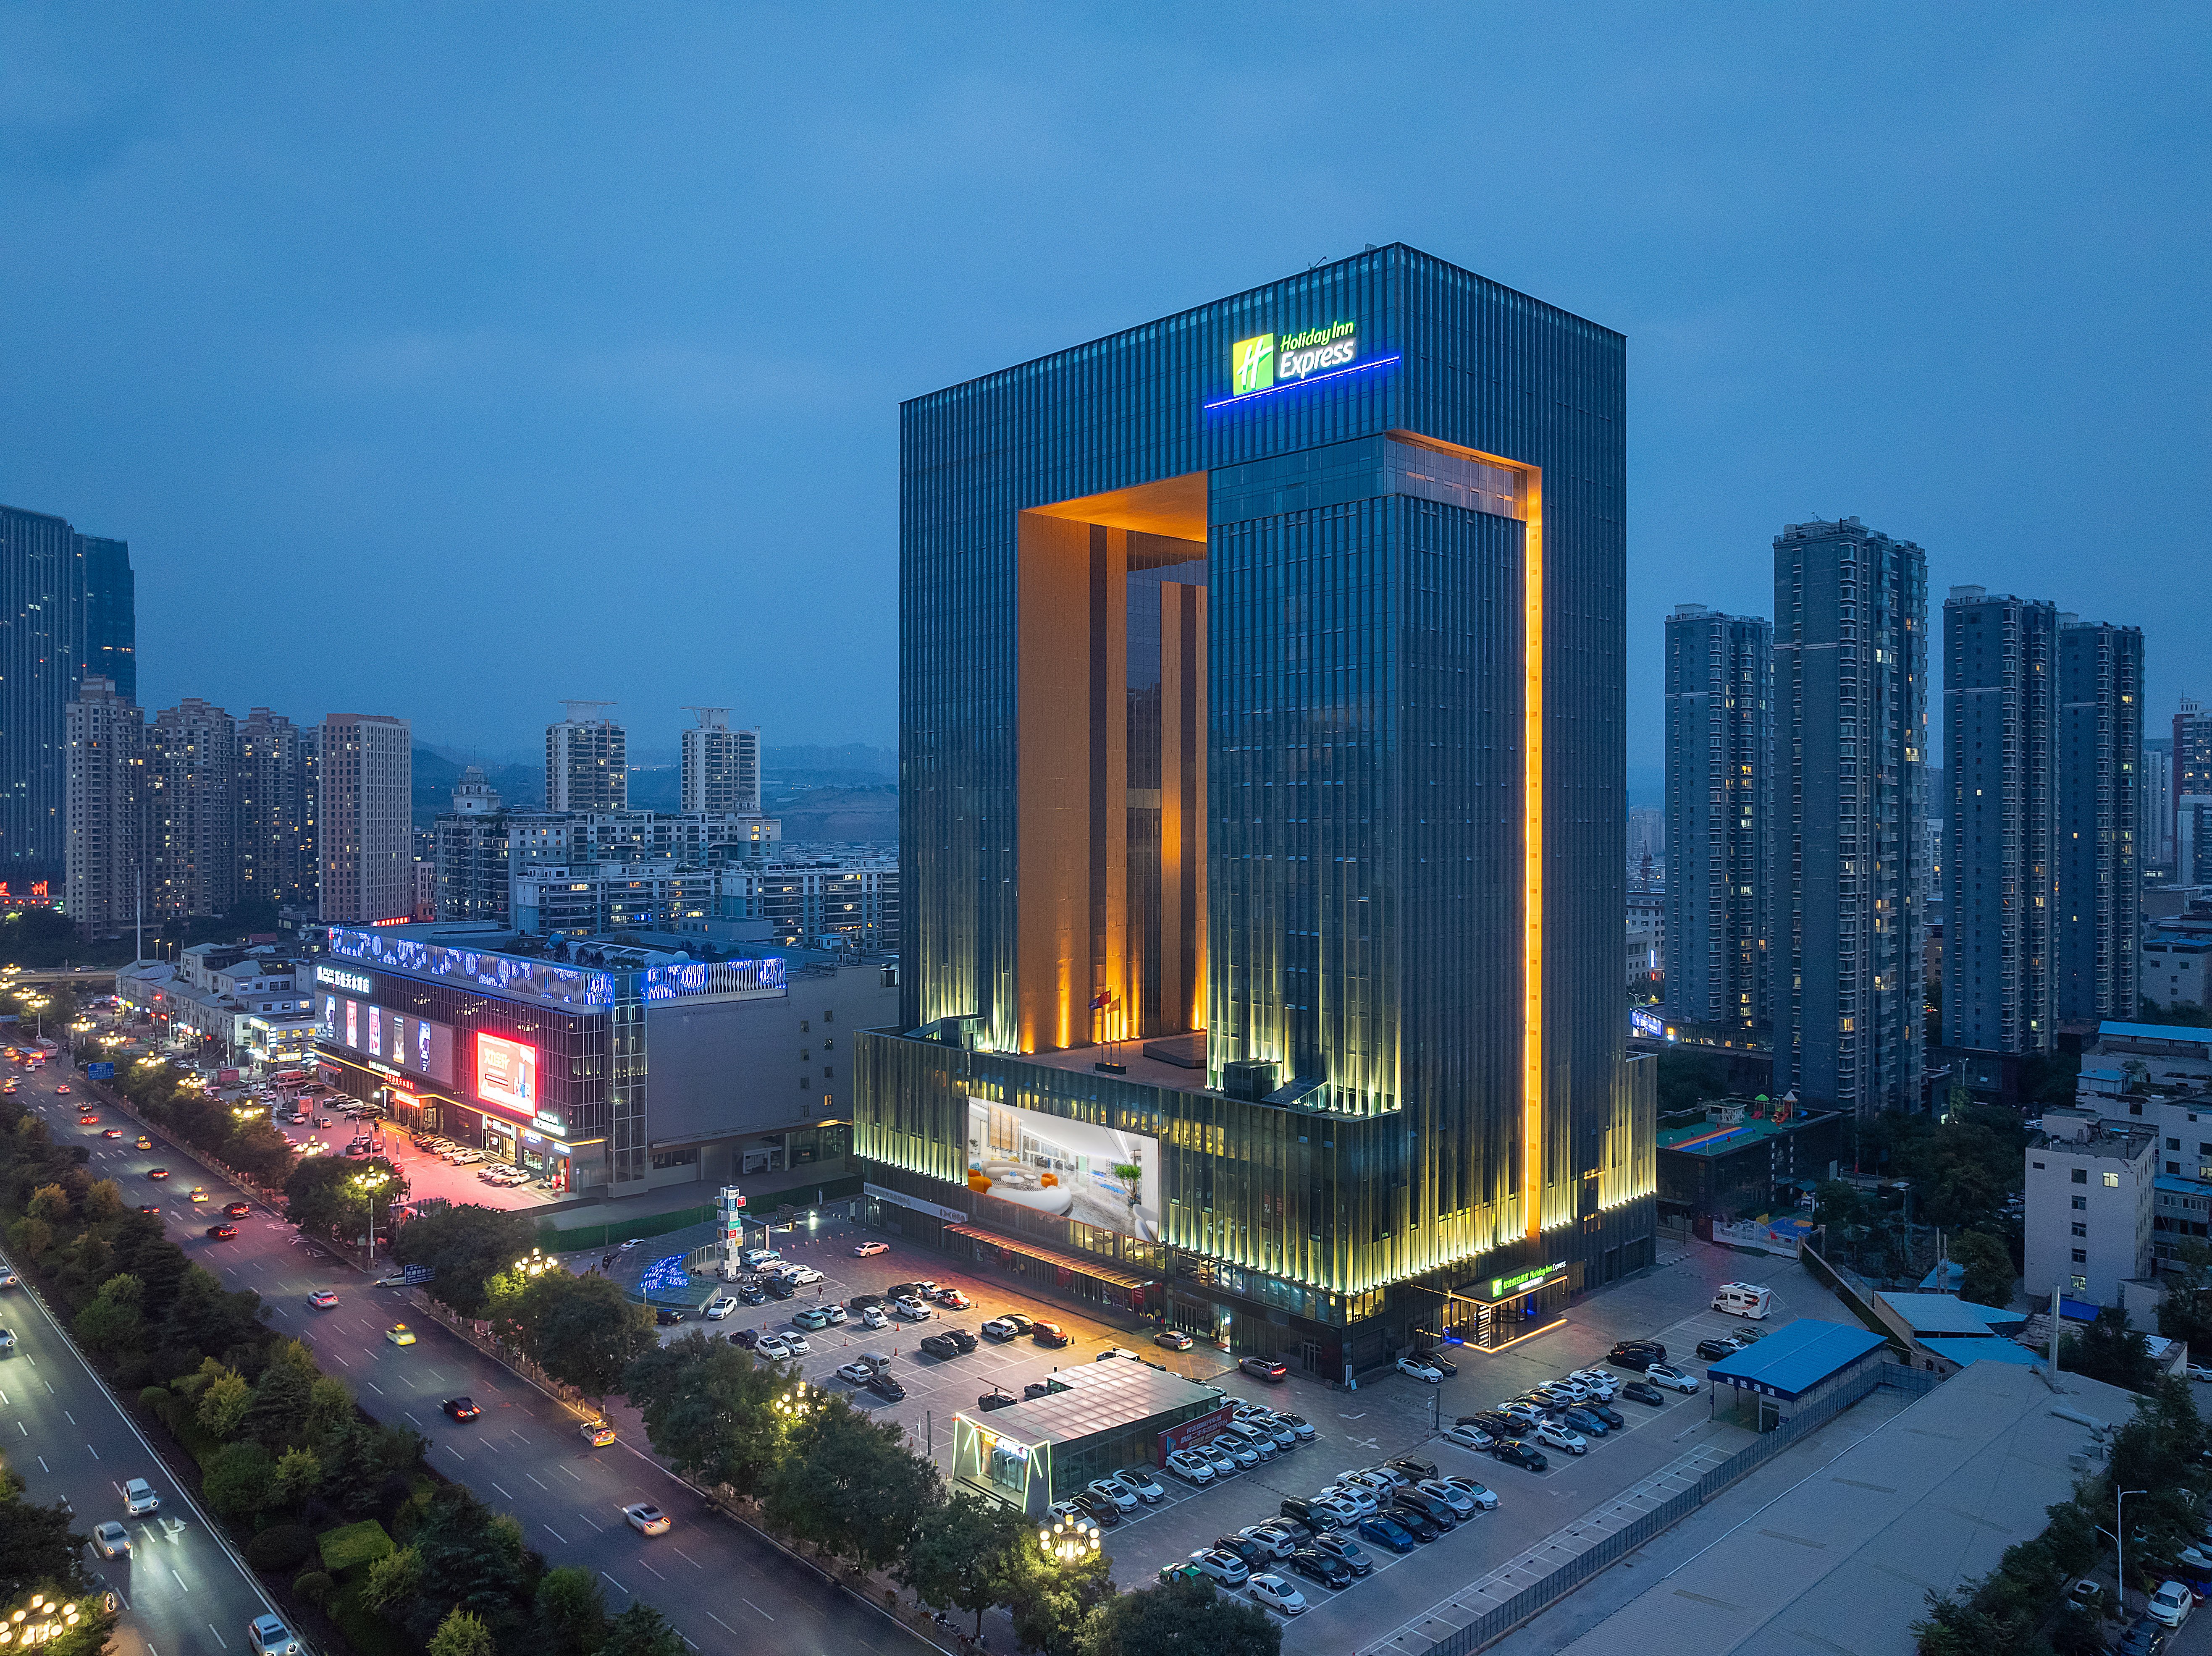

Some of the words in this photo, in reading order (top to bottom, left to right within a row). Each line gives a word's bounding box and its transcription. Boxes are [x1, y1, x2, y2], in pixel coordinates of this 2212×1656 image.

[1280, 328, 1330, 352] Holiday
[1332, 321, 1354, 339] Inn
[1279, 341, 1354, 379] Express
[1530, 1268, 1546, 1279] Holiday
[1552, 1260, 1566, 1271] Express
[1727, 1377, 1775, 1396] 查验通道
